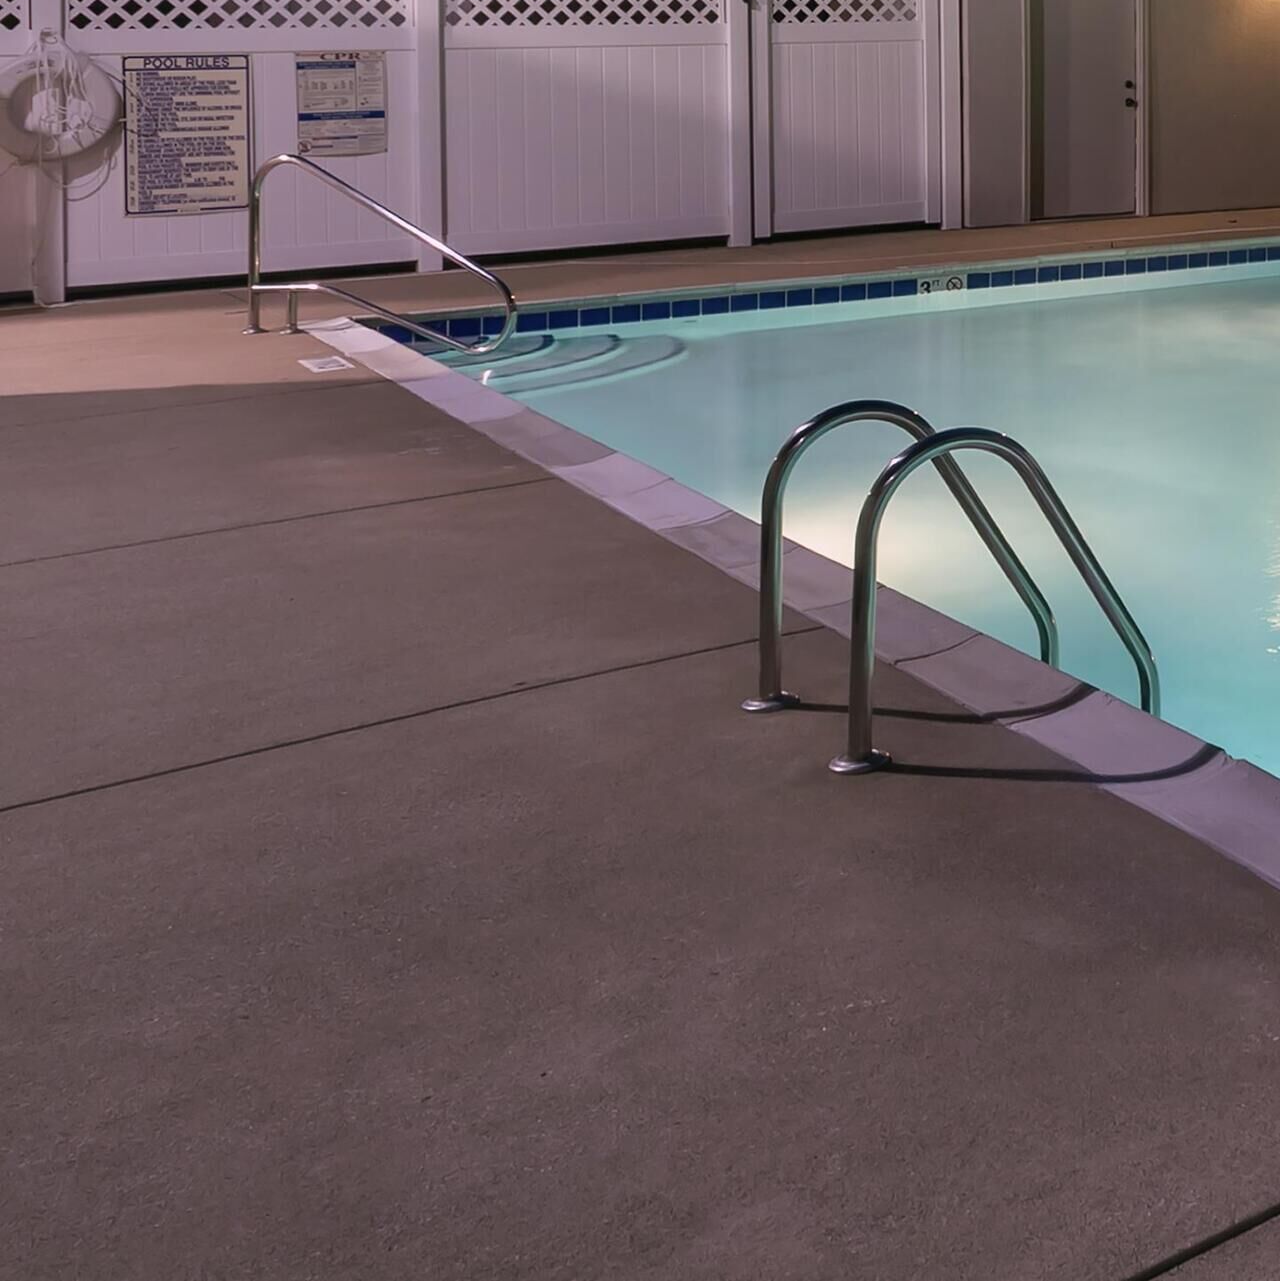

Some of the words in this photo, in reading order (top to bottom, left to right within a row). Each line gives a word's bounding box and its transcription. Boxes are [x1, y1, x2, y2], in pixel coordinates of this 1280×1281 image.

[143, 56, 182, 69] POOL
[186, 55, 231, 68] RULES
[320, 52, 361, 61] CPR
